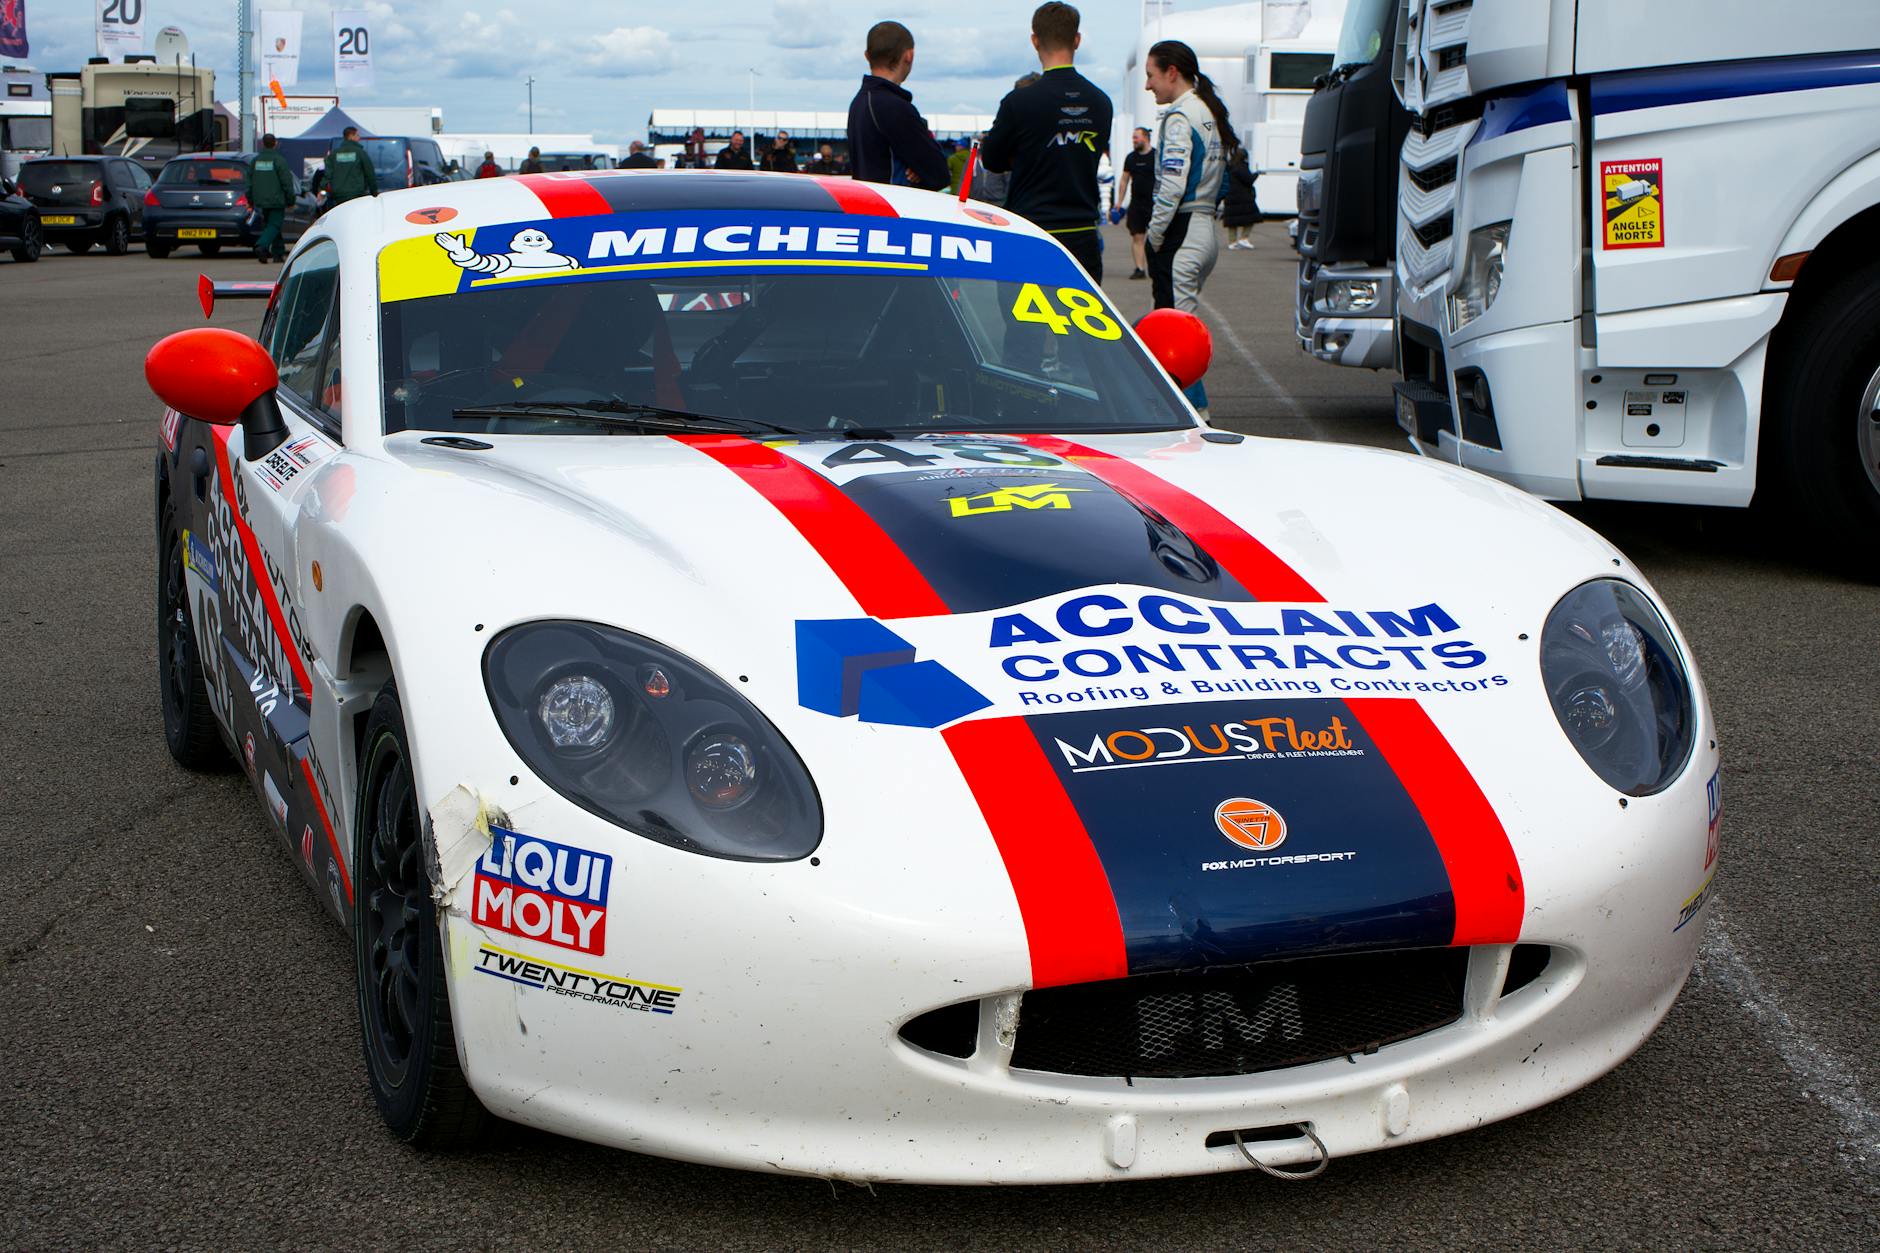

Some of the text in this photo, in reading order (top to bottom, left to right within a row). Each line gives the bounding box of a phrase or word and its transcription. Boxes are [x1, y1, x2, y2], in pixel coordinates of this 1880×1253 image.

[102, 0, 142, 25] 20
[338, 27, 369, 55] 20
[1046, 130, 1099, 152] AMR
[1605, 162, 1660, 174] ATTENTION
[1612, 220, 1656, 232] ANGLES
[1614, 230, 1654, 241] MORTS
[588, 224, 993, 264] MICHELIN
[1011, 282, 1123, 341] 48
[821, 442, 1064, 469] 48
[210, 464, 294, 706] ACCLAIM
[989, 594, 1461, 648] ACCLAIM
[1001, 640, 1487, 682] CONTRACTS
[1018, 674, 1509, 706] Roofing & Building Contractors
[1246, 748, 1365, 760] DRIVER & FLEET MANAGEMENT
[481, 834, 606, 901] LIQUI
[1201, 852, 1357, 871] FOX MOTORSPORT
[477, 879, 605, 949] MOLY
[479, 948, 681, 1009] TWENTYONE
[546, 984, 653, 1012] PERFORMANCE
